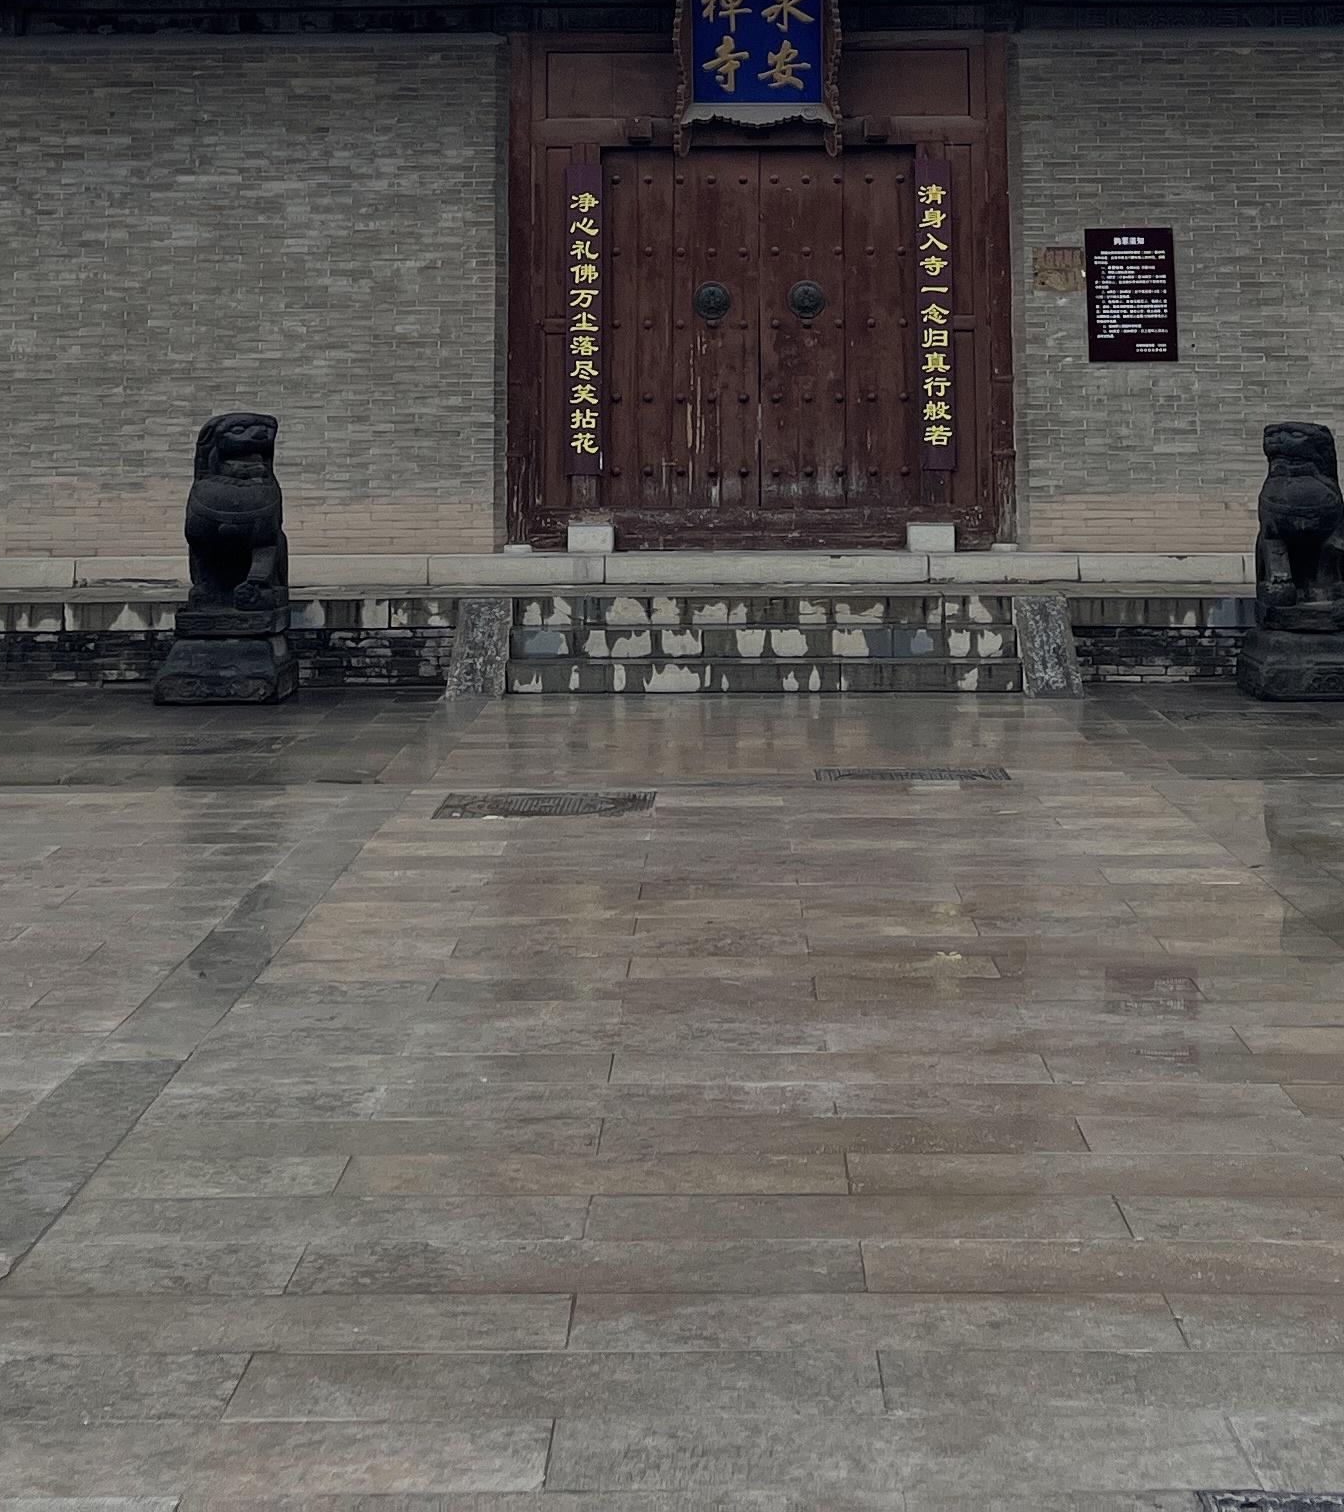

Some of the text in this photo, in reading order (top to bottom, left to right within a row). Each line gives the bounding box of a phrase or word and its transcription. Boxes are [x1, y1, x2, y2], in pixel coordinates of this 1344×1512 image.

[569, 192, 600, 454] 净心礼佛万尘落尽笑拈花
[917, 183, 953, 447] 清身入寺一念归真行般若
